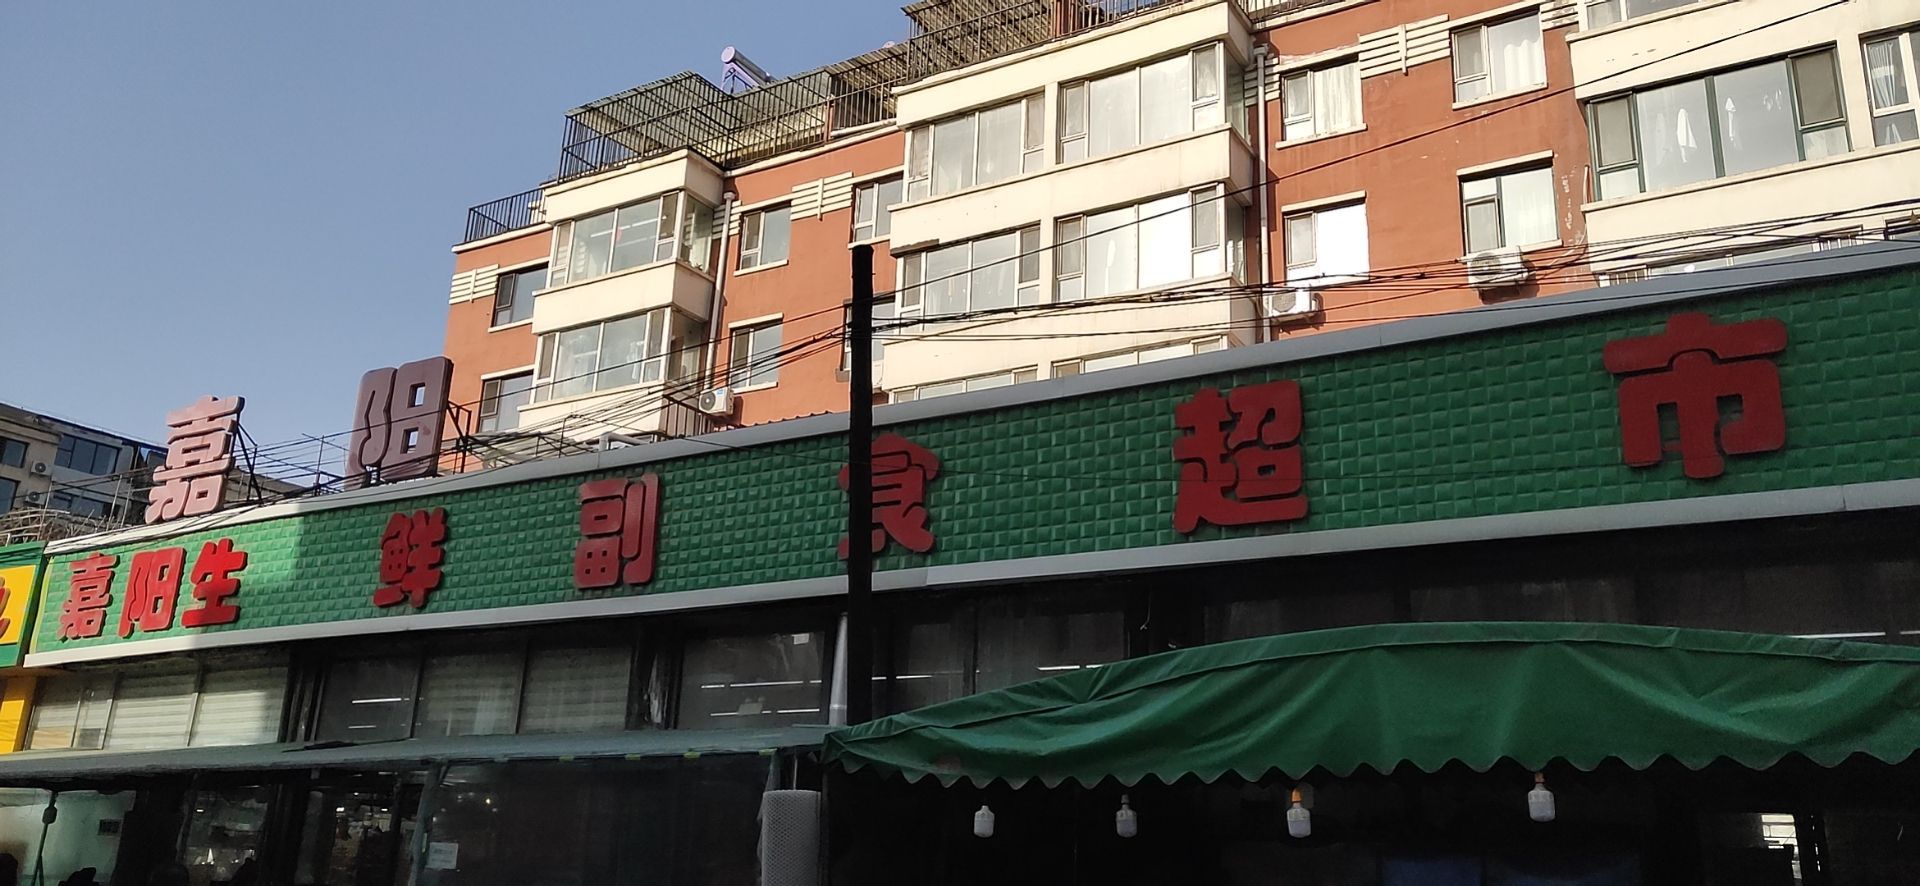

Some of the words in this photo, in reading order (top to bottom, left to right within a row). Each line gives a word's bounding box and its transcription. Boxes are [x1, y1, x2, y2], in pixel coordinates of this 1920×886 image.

[57, 311, 1788, 640] 嘉阳生鲜副食超市
[145, 356, 454, 525] 嘉阳
